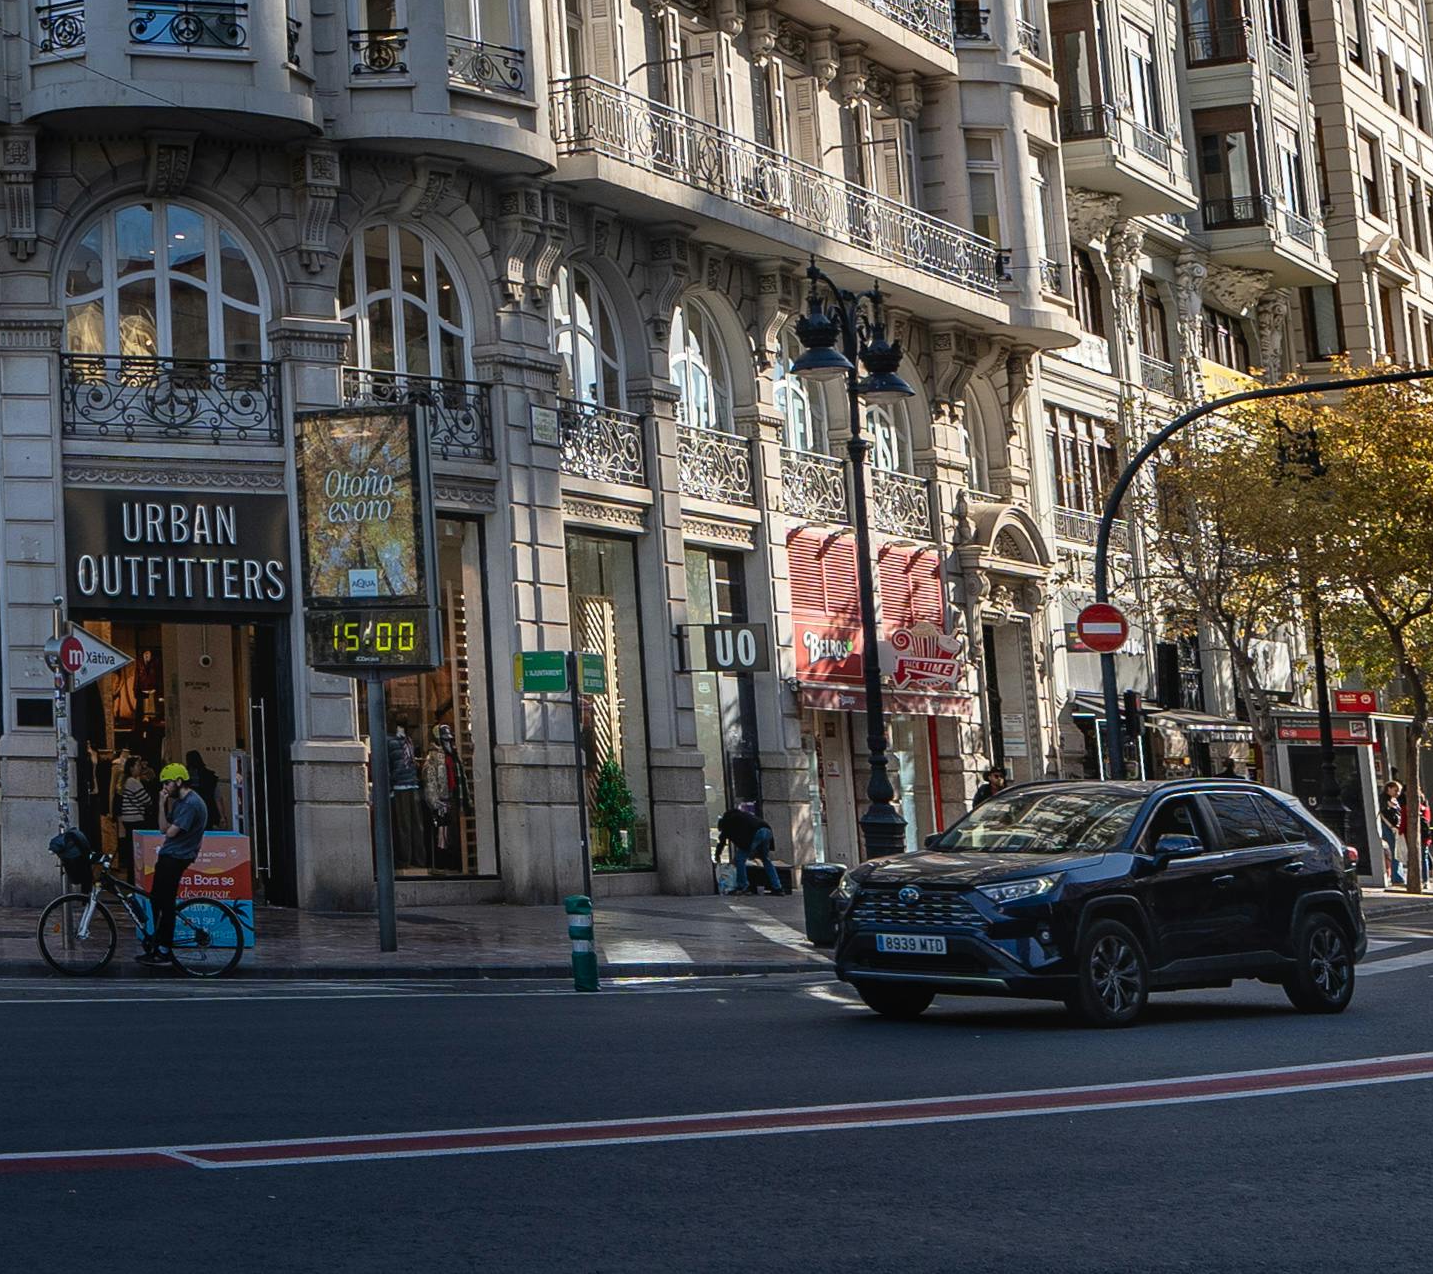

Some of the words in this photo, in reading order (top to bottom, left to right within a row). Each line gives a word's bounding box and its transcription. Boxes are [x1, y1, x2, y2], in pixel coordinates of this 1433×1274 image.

[325, 467, 393, 498] Otoño
[328, 501, 349, 523] es
[353, 499, 392, 522] oro
[122, 502, 237, 545] URBAN
[78, 554, 285, 601] OUTFITTERS
[352, 578, 376, 589] AQUA
[333, 622, 414, 651] 15:00
[714, 629, 756, 667] UO
[86, 651, 115, 664] Xàtiva
[923, 663, 953, 675] TIME
[194, 874, 220, 886] Bora
[222, 877, 235, 886] se
[885, 937, 916, 951] 8939
[919, 938, 944, 952] MTD
